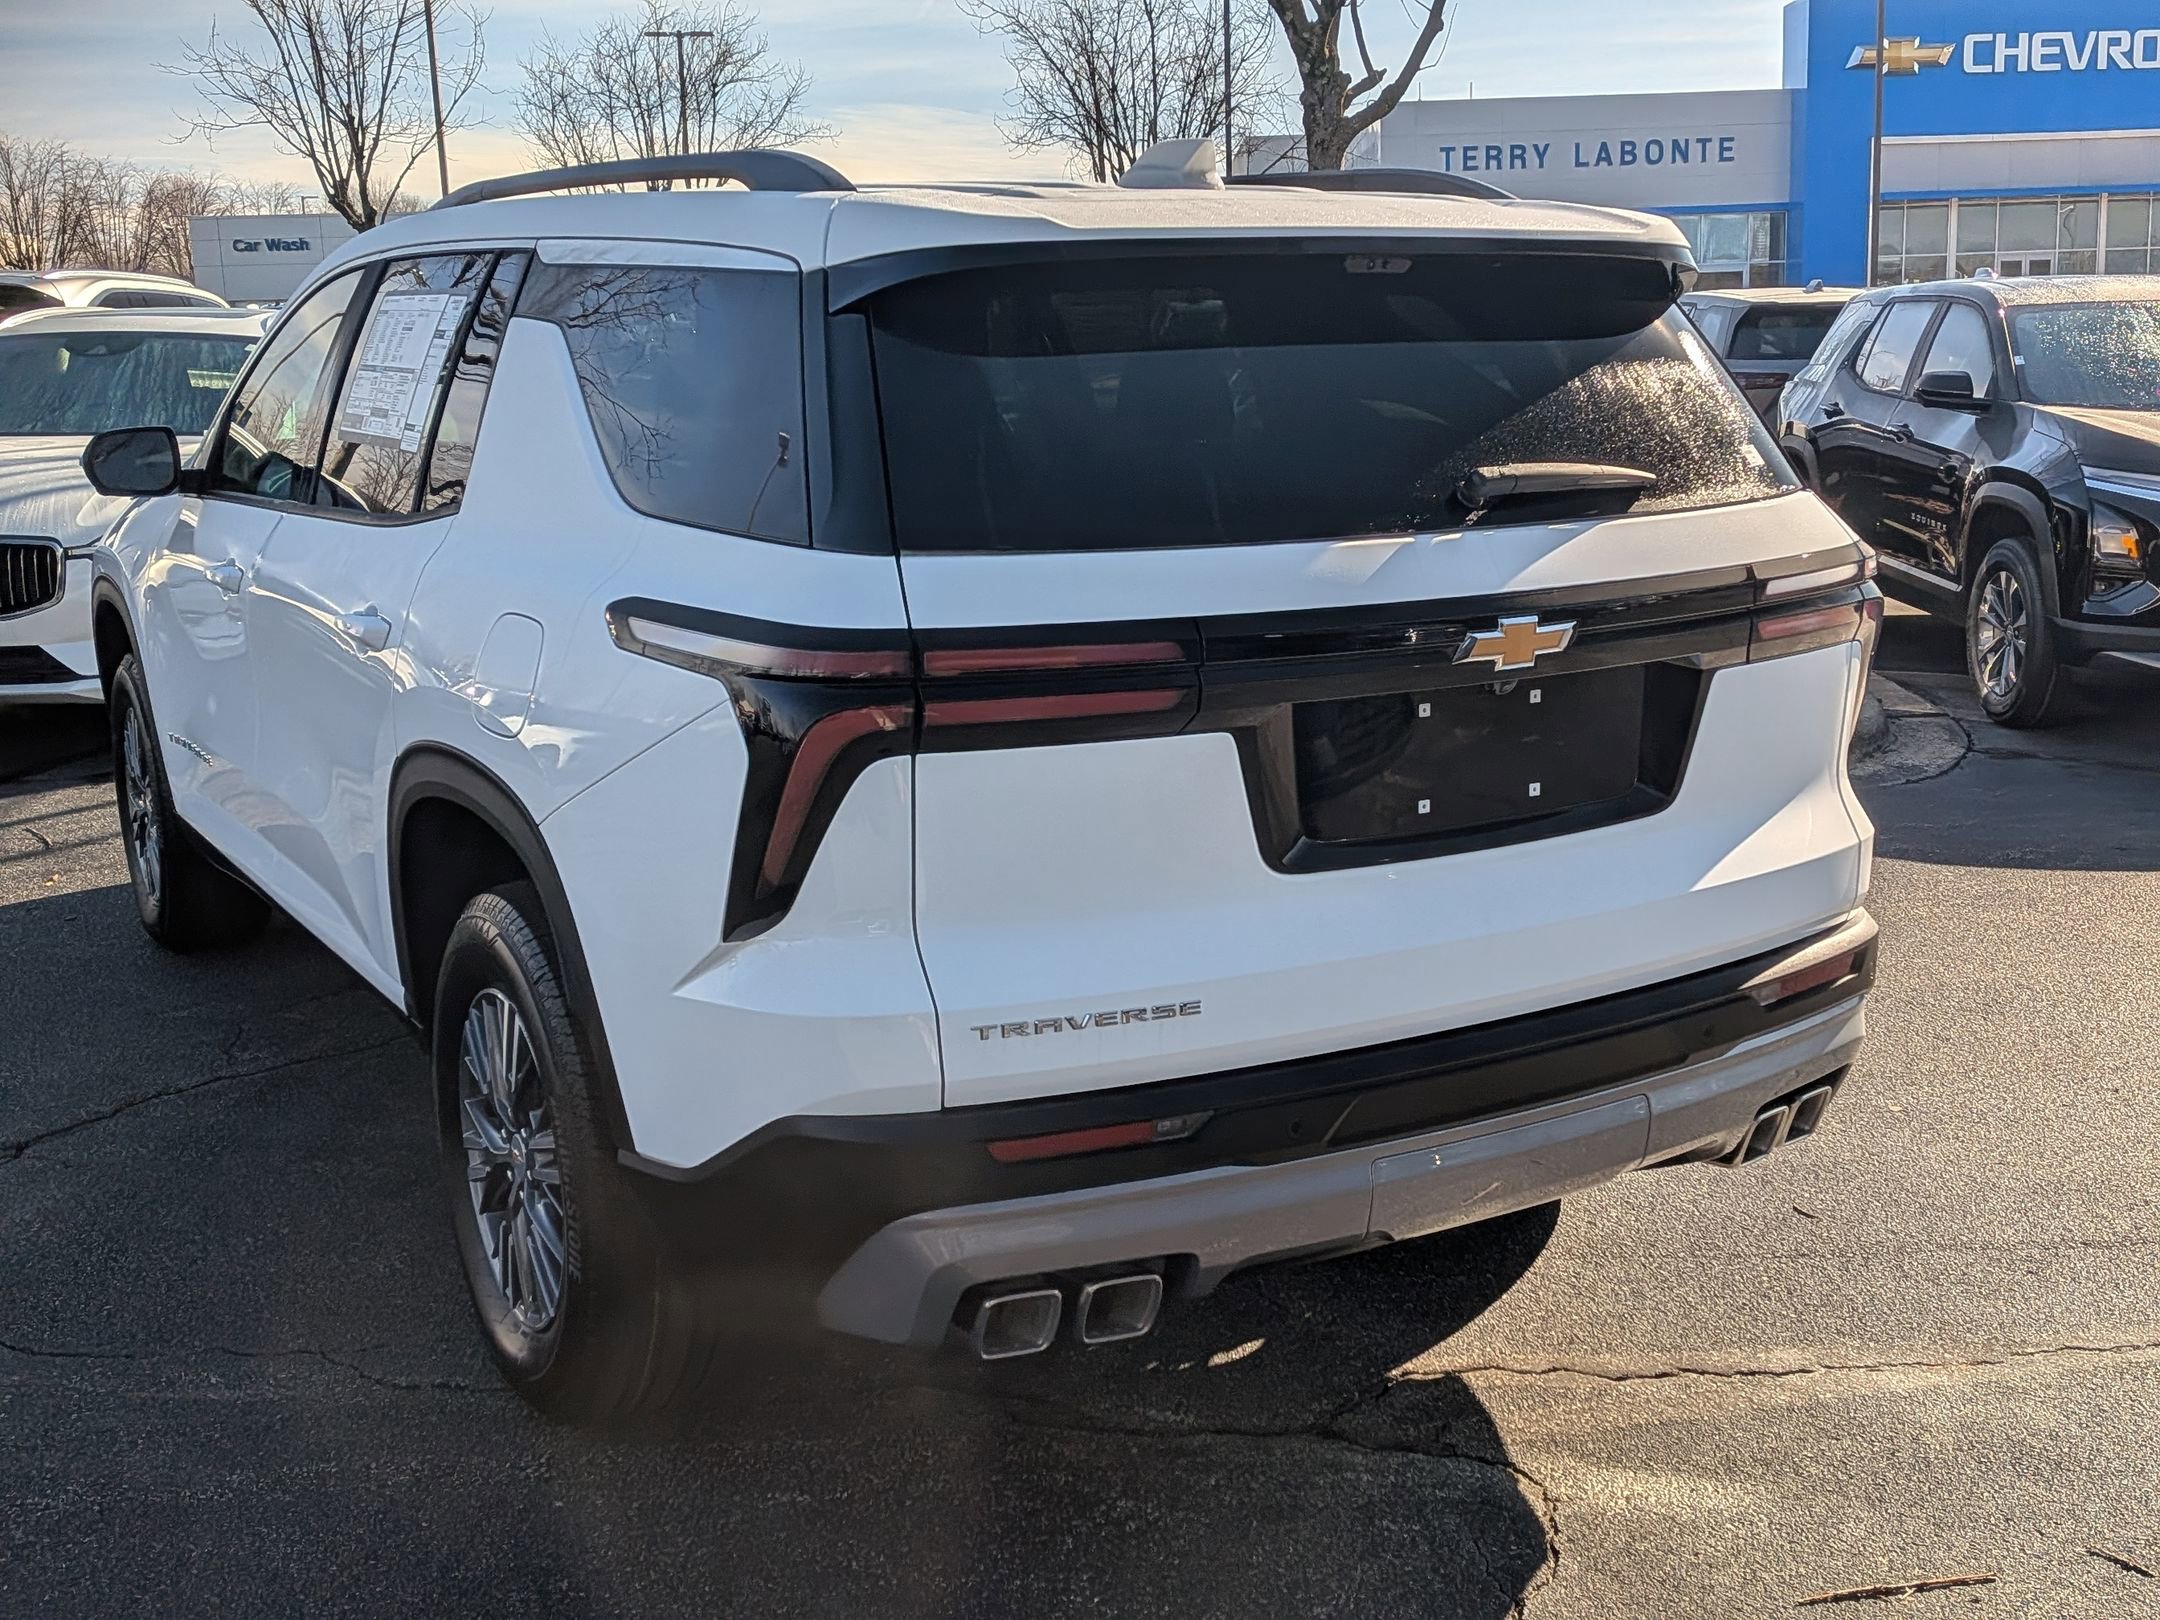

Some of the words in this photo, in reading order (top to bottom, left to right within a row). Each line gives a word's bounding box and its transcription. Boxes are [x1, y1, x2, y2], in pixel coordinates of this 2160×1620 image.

[1963, 30, 2160, 73] CHEVRO
[1440, 143, 1550, 172] TERRY
[1574, 137, 1736, 168] LABONTE
[233, 239, 262, 252] Car
[264, 237, 310, 252] Wash
[970, 1000, 1202, 1041] TRAVERSE
